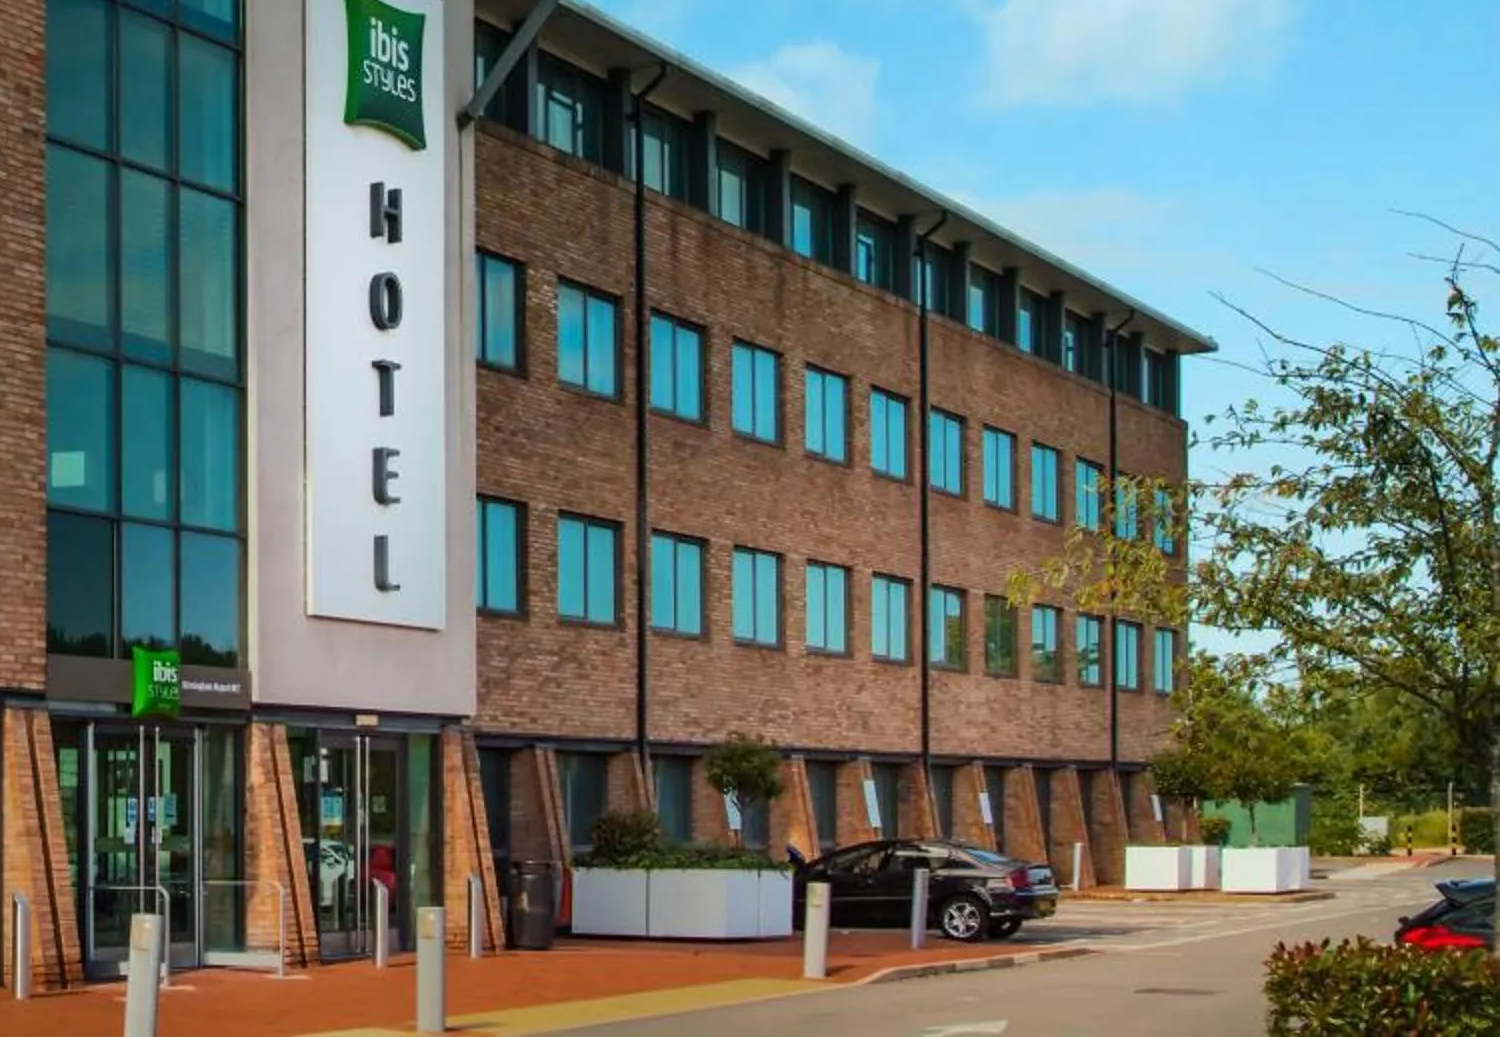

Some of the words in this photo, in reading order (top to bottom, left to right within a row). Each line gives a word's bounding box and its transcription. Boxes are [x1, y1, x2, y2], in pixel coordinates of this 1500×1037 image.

[370, 16, 409, 72] ibis
[369, 181, 403, 593] HOTEL
[153, 659, 179, 683] ibis
